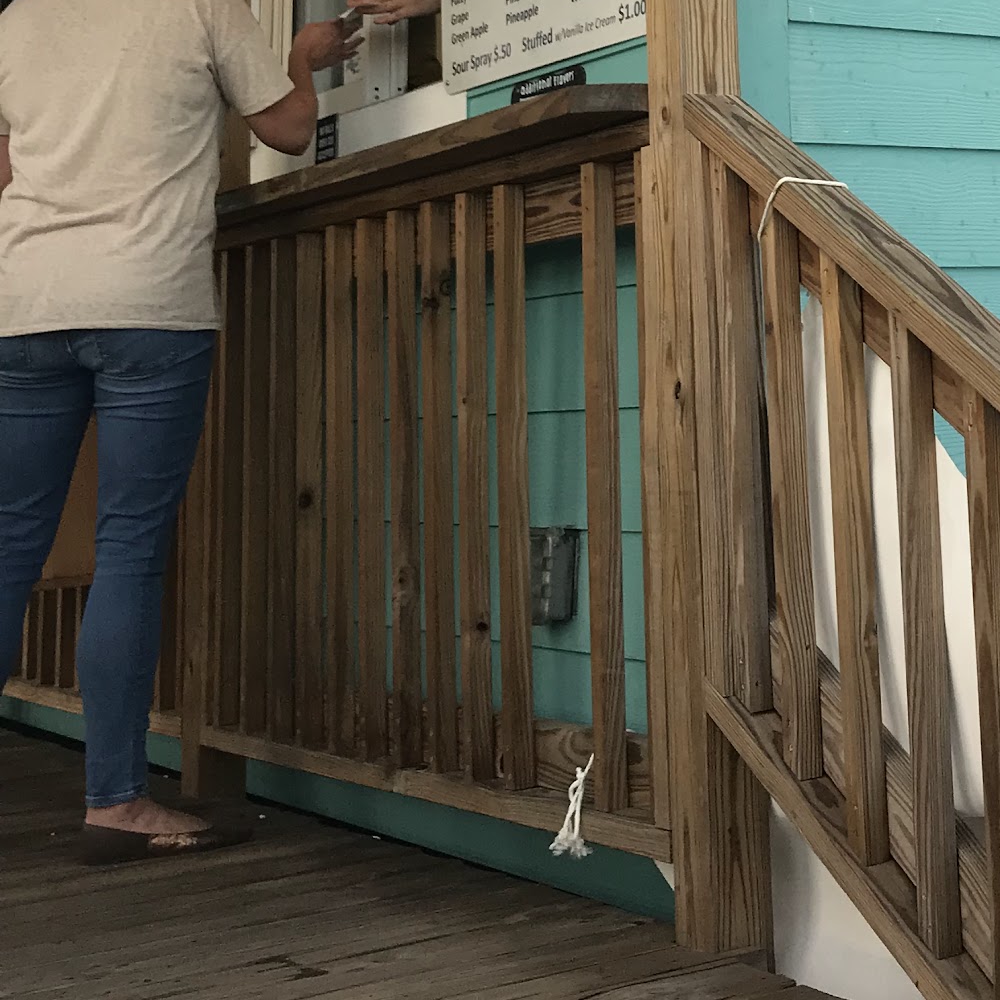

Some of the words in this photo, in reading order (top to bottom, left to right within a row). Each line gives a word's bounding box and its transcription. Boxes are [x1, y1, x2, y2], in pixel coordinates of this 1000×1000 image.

[450, 11, 469, 26] Grape
[505, 4, 539, 26] Pineapple
[451, 31, 469, 45] Green
[470, 21, 489, 40] Apple
[452, 60, 469, 77] Sour
[470, 53, 492, 72] Spray
[493, 42, 512, 64] $.50
[521, 27, 553, 53] Stuffed
[618, 0, 647, 24] $1.00
